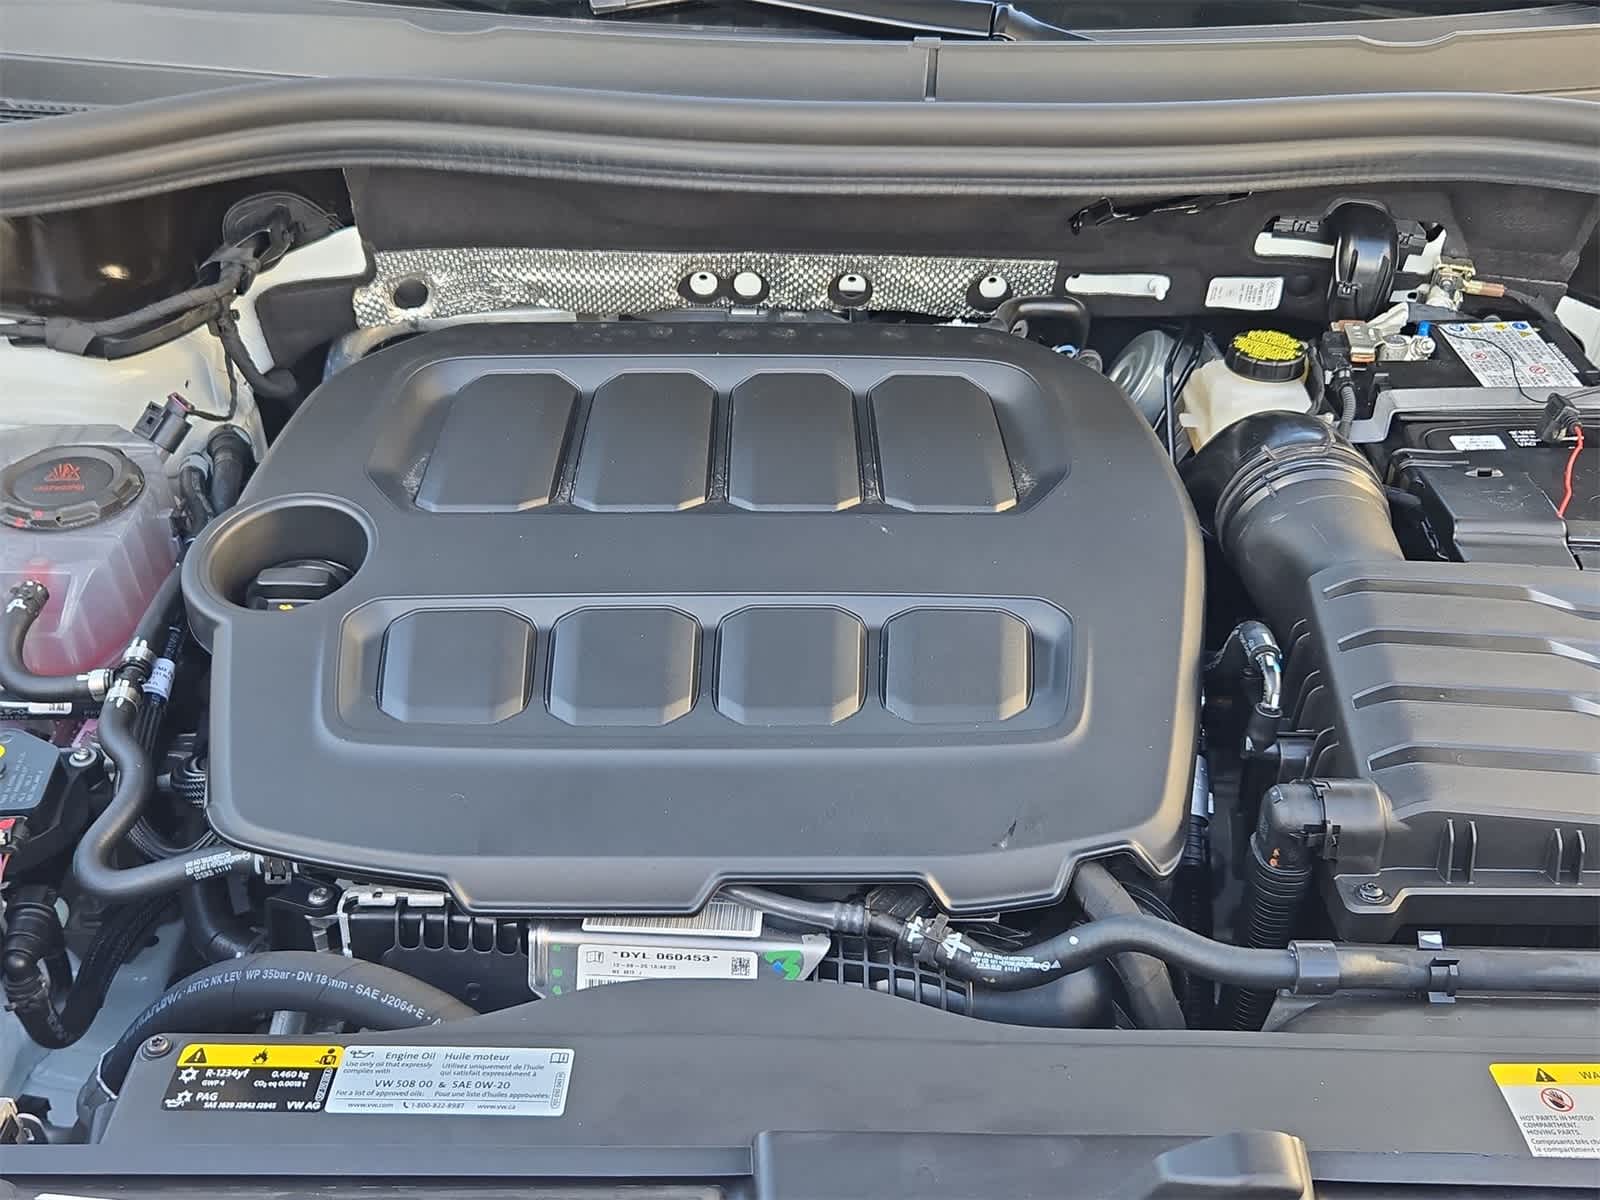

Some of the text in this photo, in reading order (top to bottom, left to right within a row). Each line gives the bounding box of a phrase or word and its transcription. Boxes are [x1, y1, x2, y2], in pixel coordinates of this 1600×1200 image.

[245, 969, 261, 980] WP
[262, 968, 291, 980] 35bar
[296, 970, 313, 982] DN
[355, 983, 381, 1000] SAE
[380, 993, 425, 1020] J2064-E
[385, 1051, 437, 1062] Engine Oil
[444, 1052, 511, 1061] Huile moteur
[469, 1063, 512, 1071] uniquement
[205, 1068, 250, 1080] R-1234yf
[271, 1070, 310, 1080] 0.460 kg
[375, 1080, 394, 1088] VW
[395, 1080, 416, 1088] 508
[417, 1080, 433, 1088] 00
[452, 1080, 472, 1089] SAE
[474, 1081, 511, 1089] 0W-20
[195, 1092, 219, 1101] PAG
[376, 1090, 409, 1098] approved
[286, 1101, 321, 1110] VW AG
